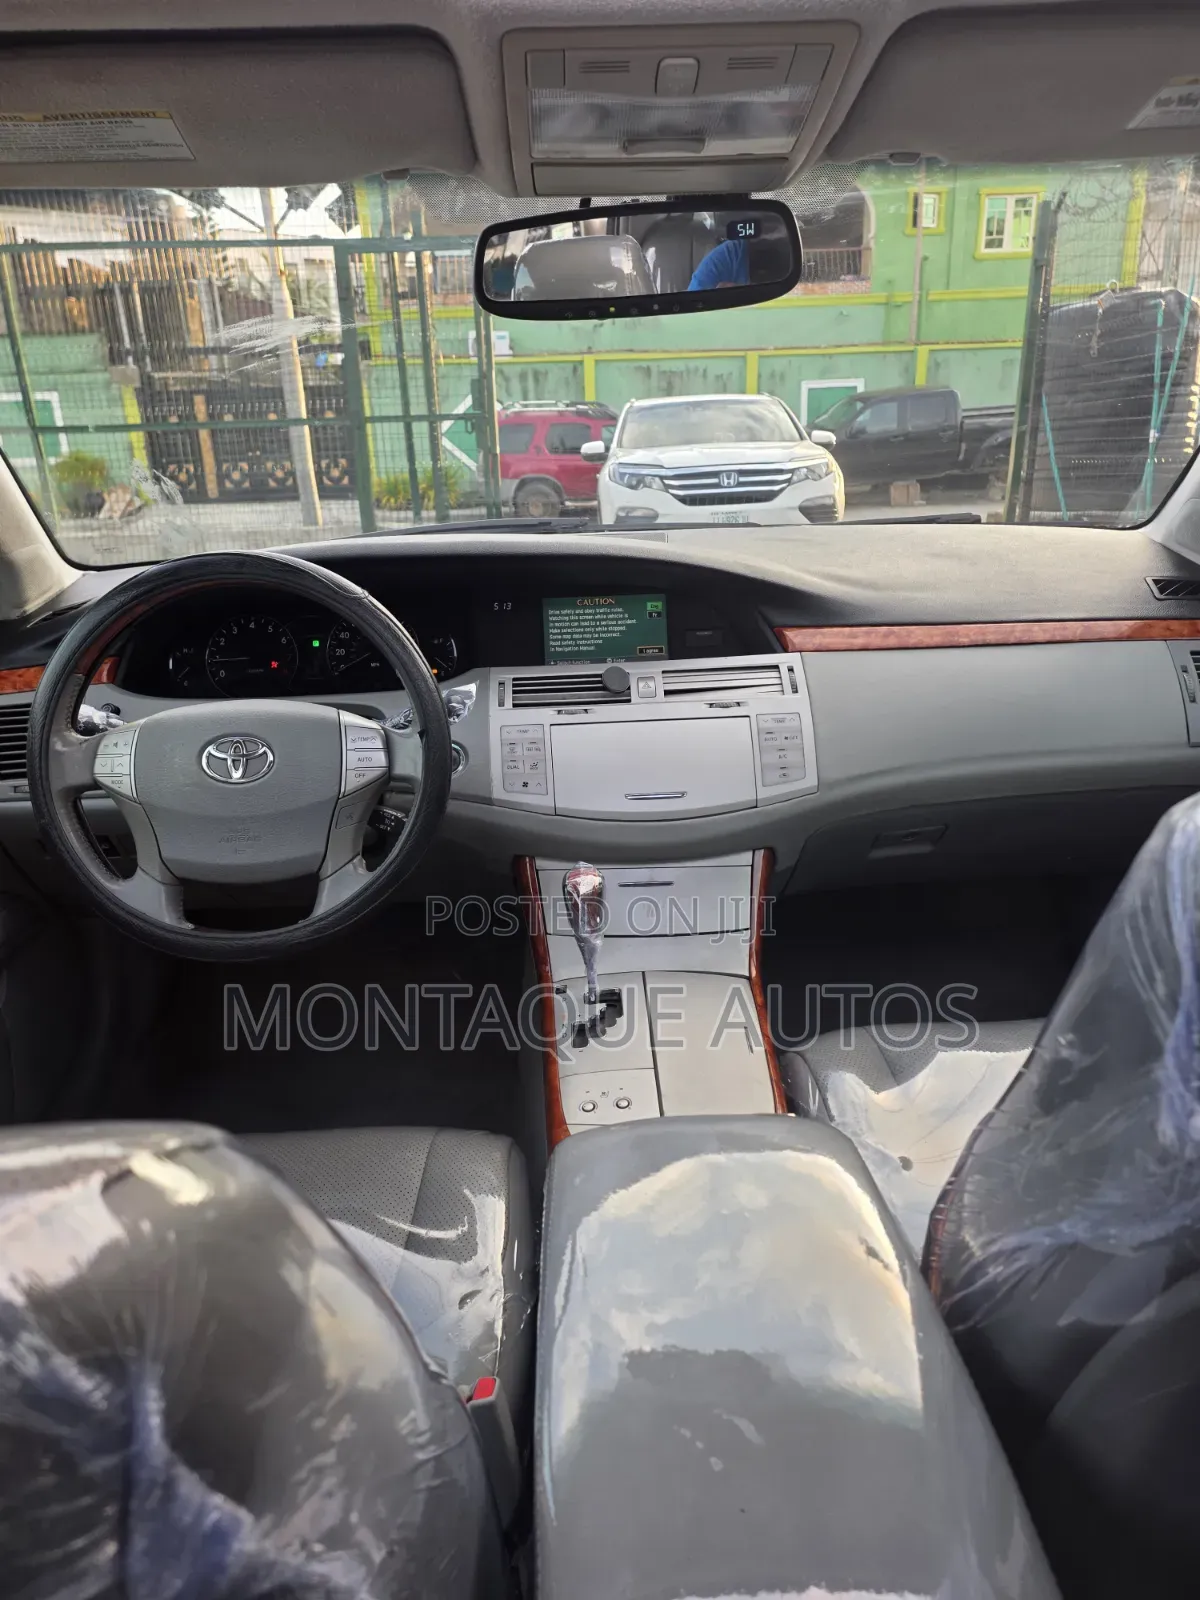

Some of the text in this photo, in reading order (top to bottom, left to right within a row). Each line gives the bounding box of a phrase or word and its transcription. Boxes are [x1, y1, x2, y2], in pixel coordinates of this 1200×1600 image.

[737, 223, 755, 237] SW
[576, 597, 615, 606] CAUTION
[248, 621, 255, 629] 4
[267, 625, 274, 633] 5
[232, 626, 238, 634] 3
[219, 638, 226, 646] 2
[281, 636, 287, 644] 6
[335, 648, 346, 656] 20
[219, 670, 226, 678] 0
